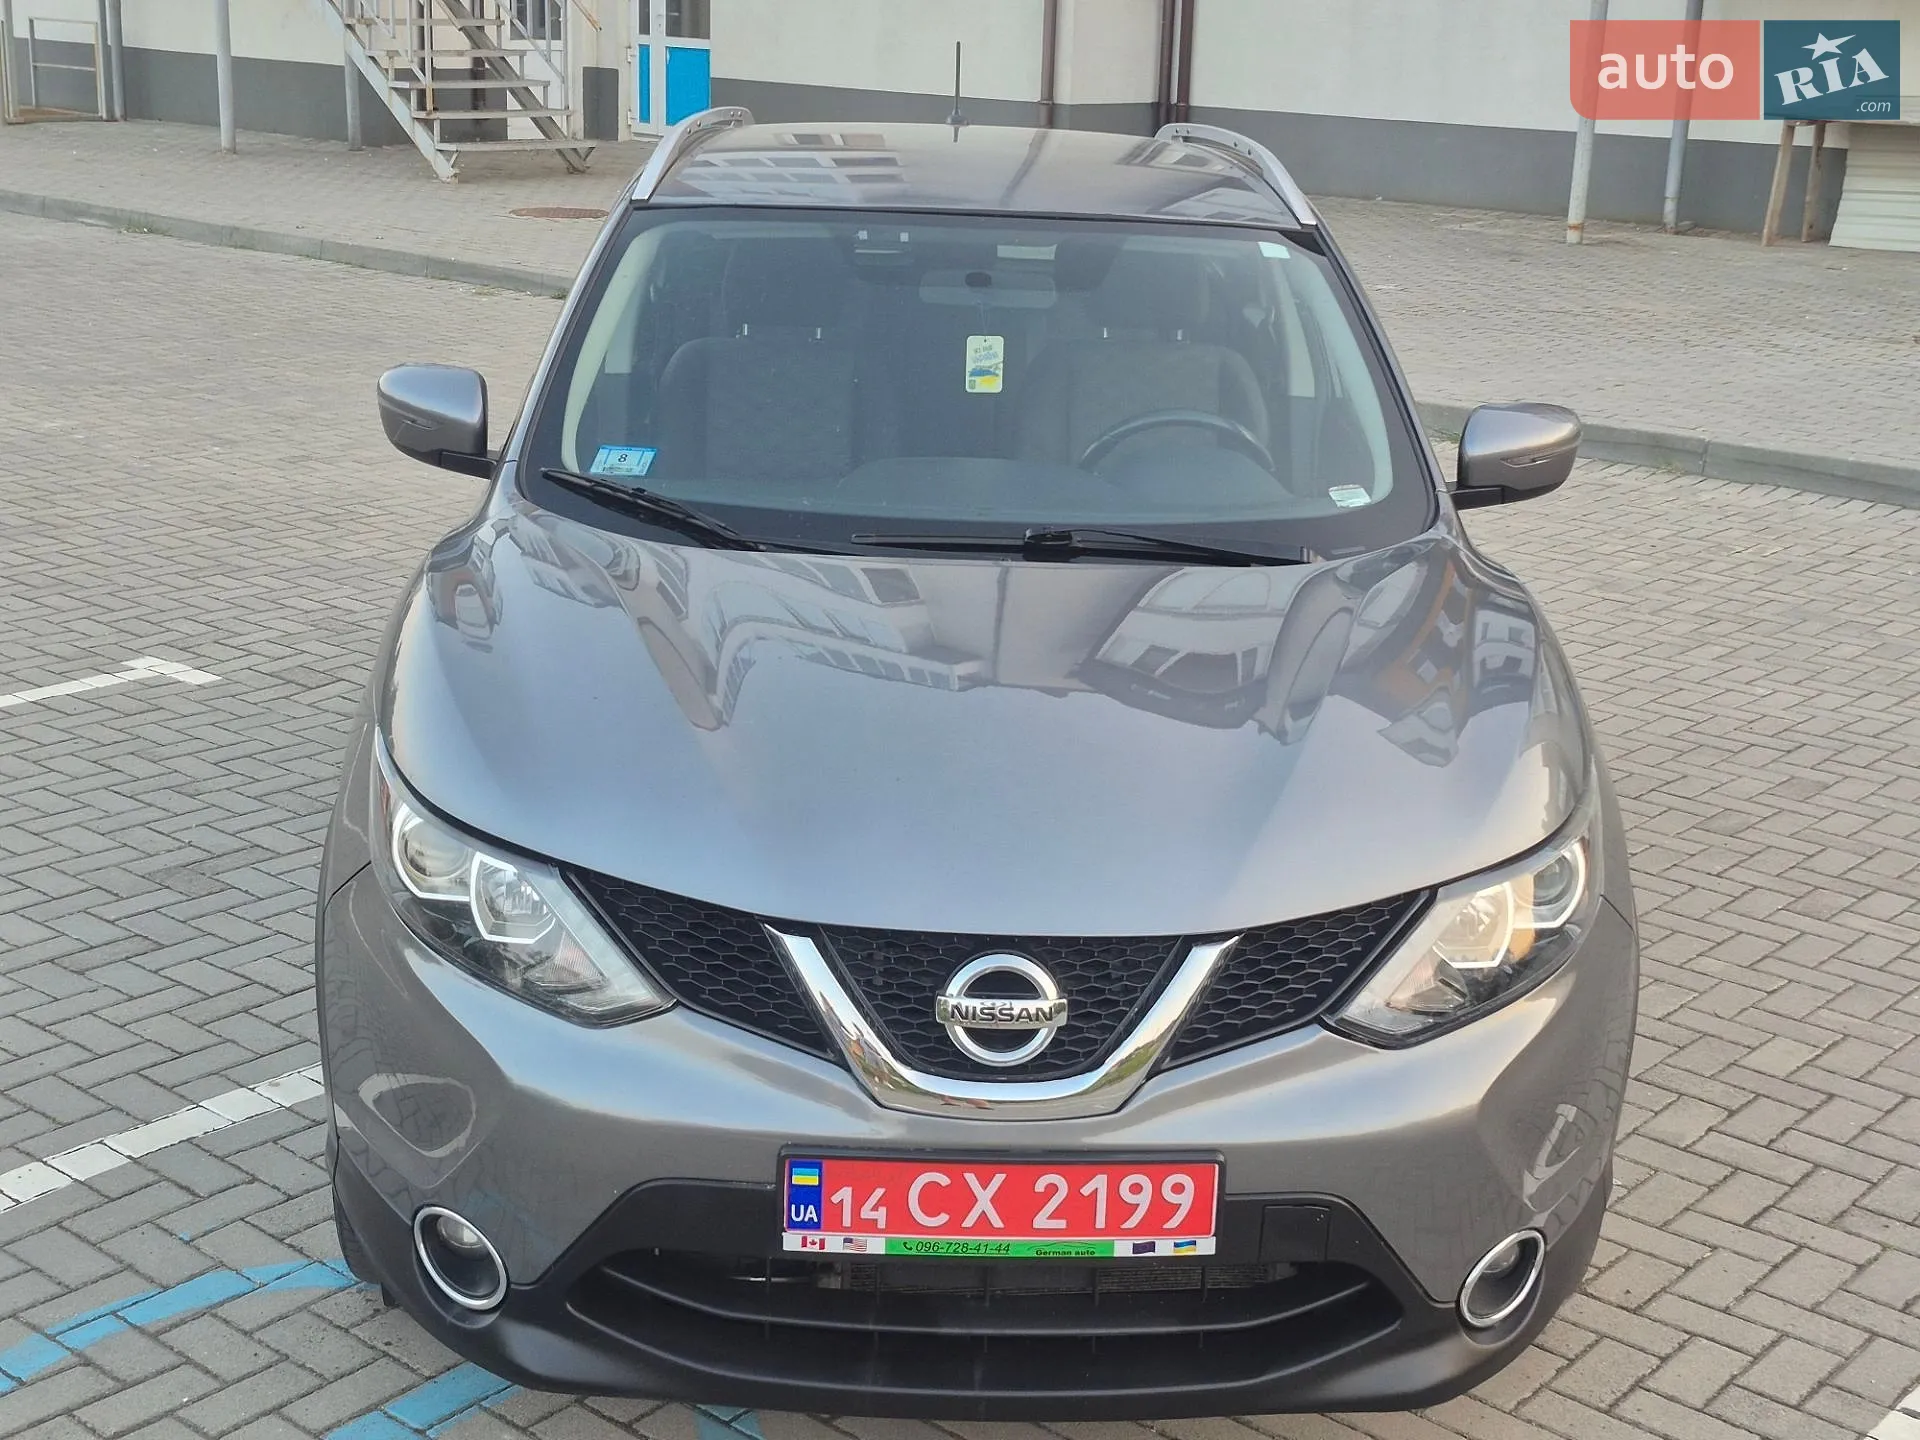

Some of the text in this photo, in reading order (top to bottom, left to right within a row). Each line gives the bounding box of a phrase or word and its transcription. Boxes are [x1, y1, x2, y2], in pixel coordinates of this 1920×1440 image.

[617, 453, 628, 463] 8
[950, 1003, 1053, 1022] NISSAN
[830, 1172, 1195, 1230] 14 CX 2199
[791, 1204, 818, 1222] UA
[915, 1240, 1011, 1254] 096-728-41-44
[1036, 1248, 1096, 1256] German auto
